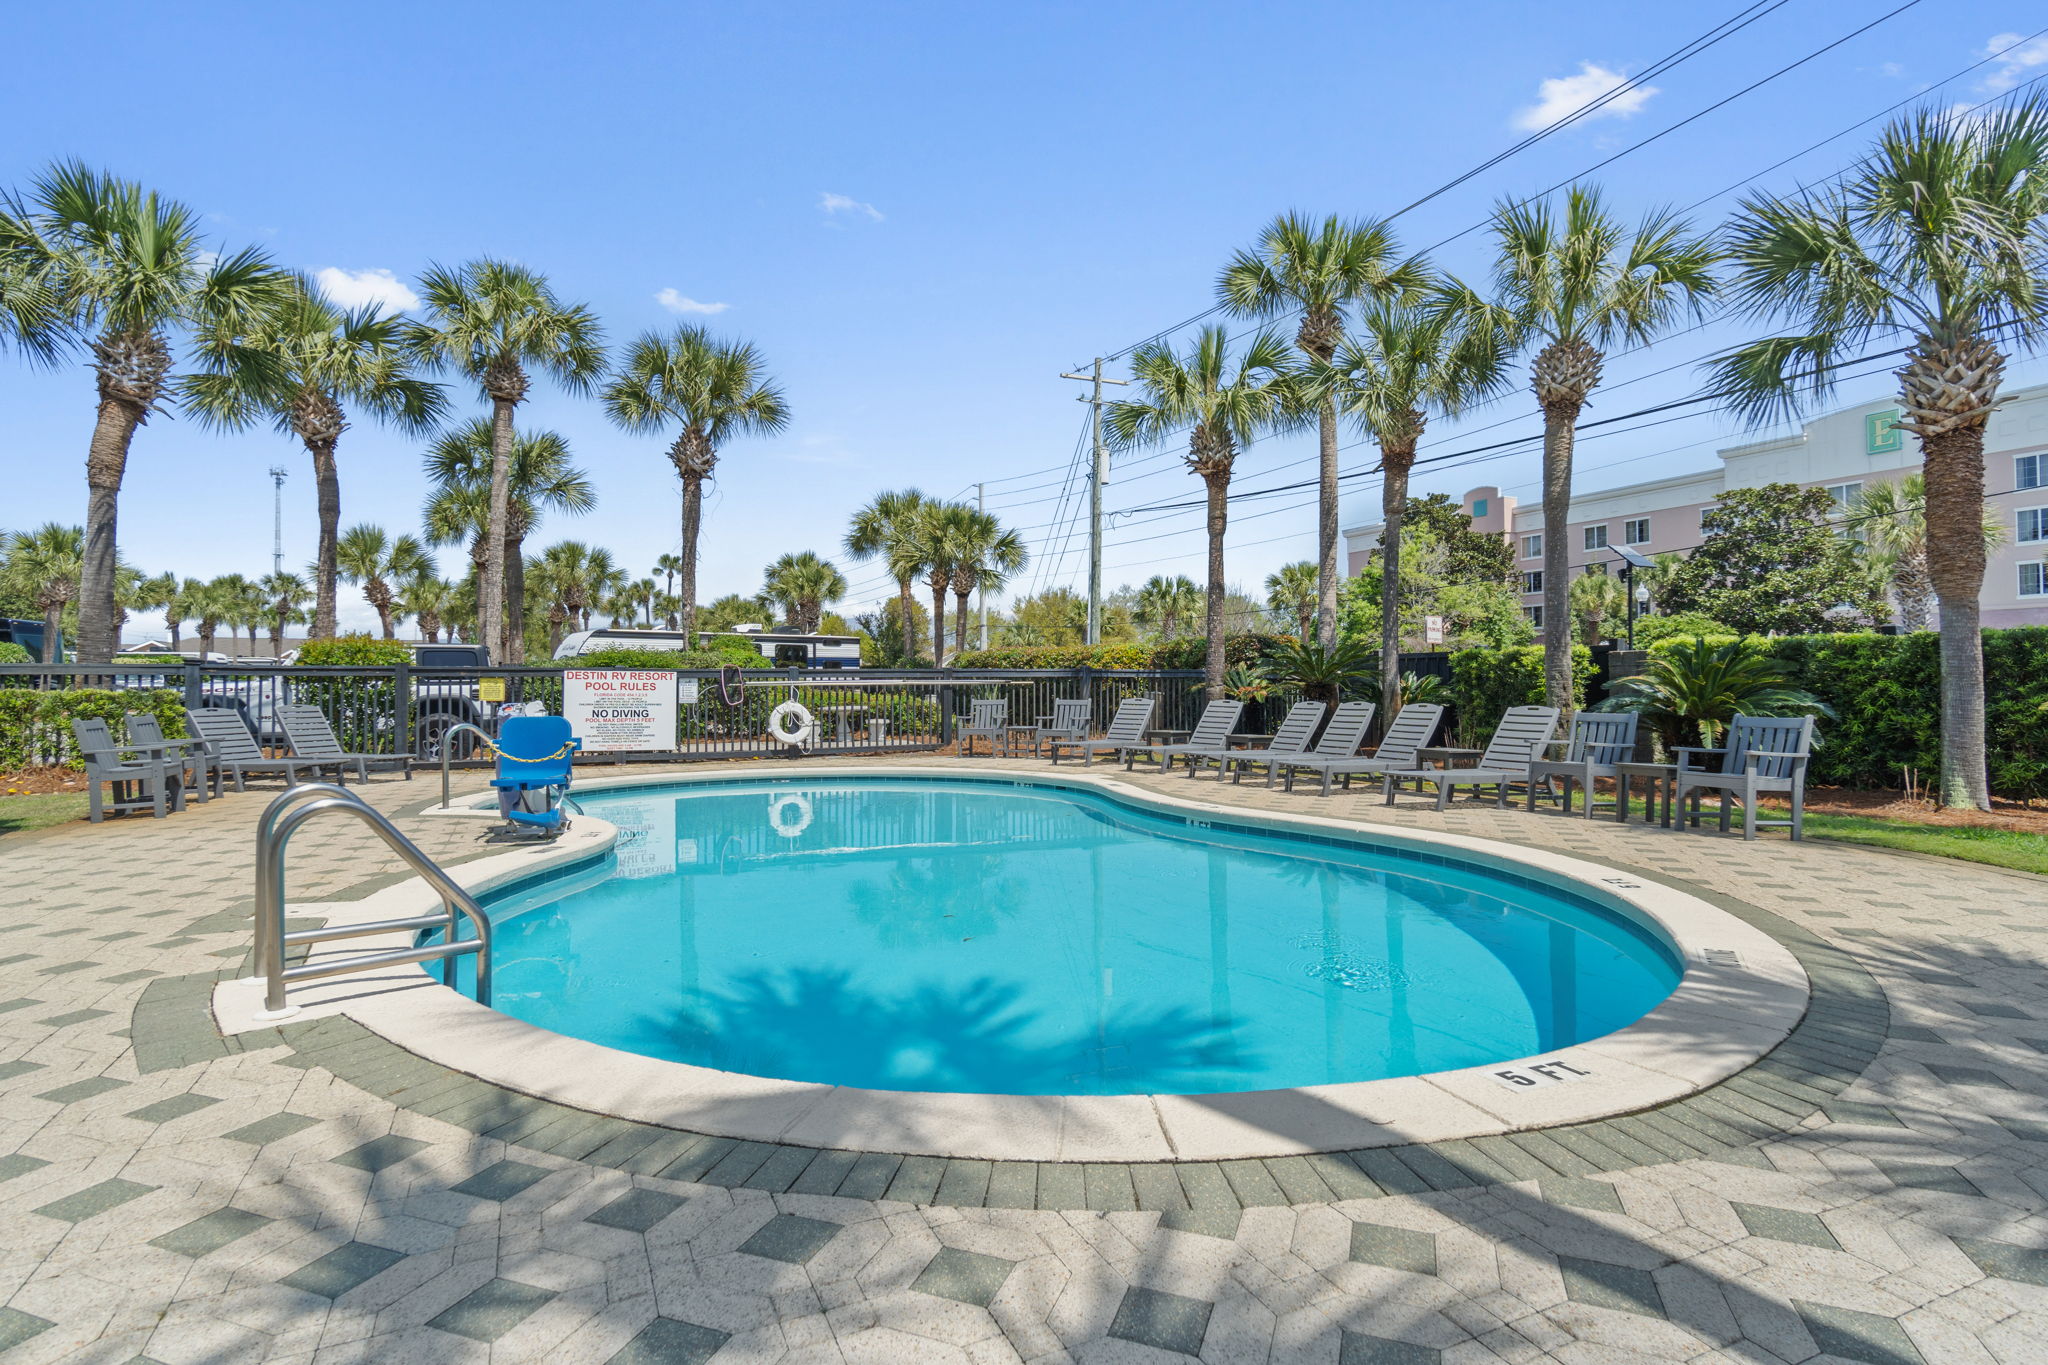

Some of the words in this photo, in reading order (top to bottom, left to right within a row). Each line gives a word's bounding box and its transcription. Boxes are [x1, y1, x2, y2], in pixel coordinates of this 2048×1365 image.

[566, 671, 608, 680] DESTIN
[611, 671, 627, 680] RV
[630, 671, 674, 680] RESORT
[585, 682, 617, 691] POOL
[620, 682, 657, 691] RULES
[592, 709, 609, 718] NO
[612, 709, 649, 718] DIVING
[1494, 1070, 1537, 1086] 5
